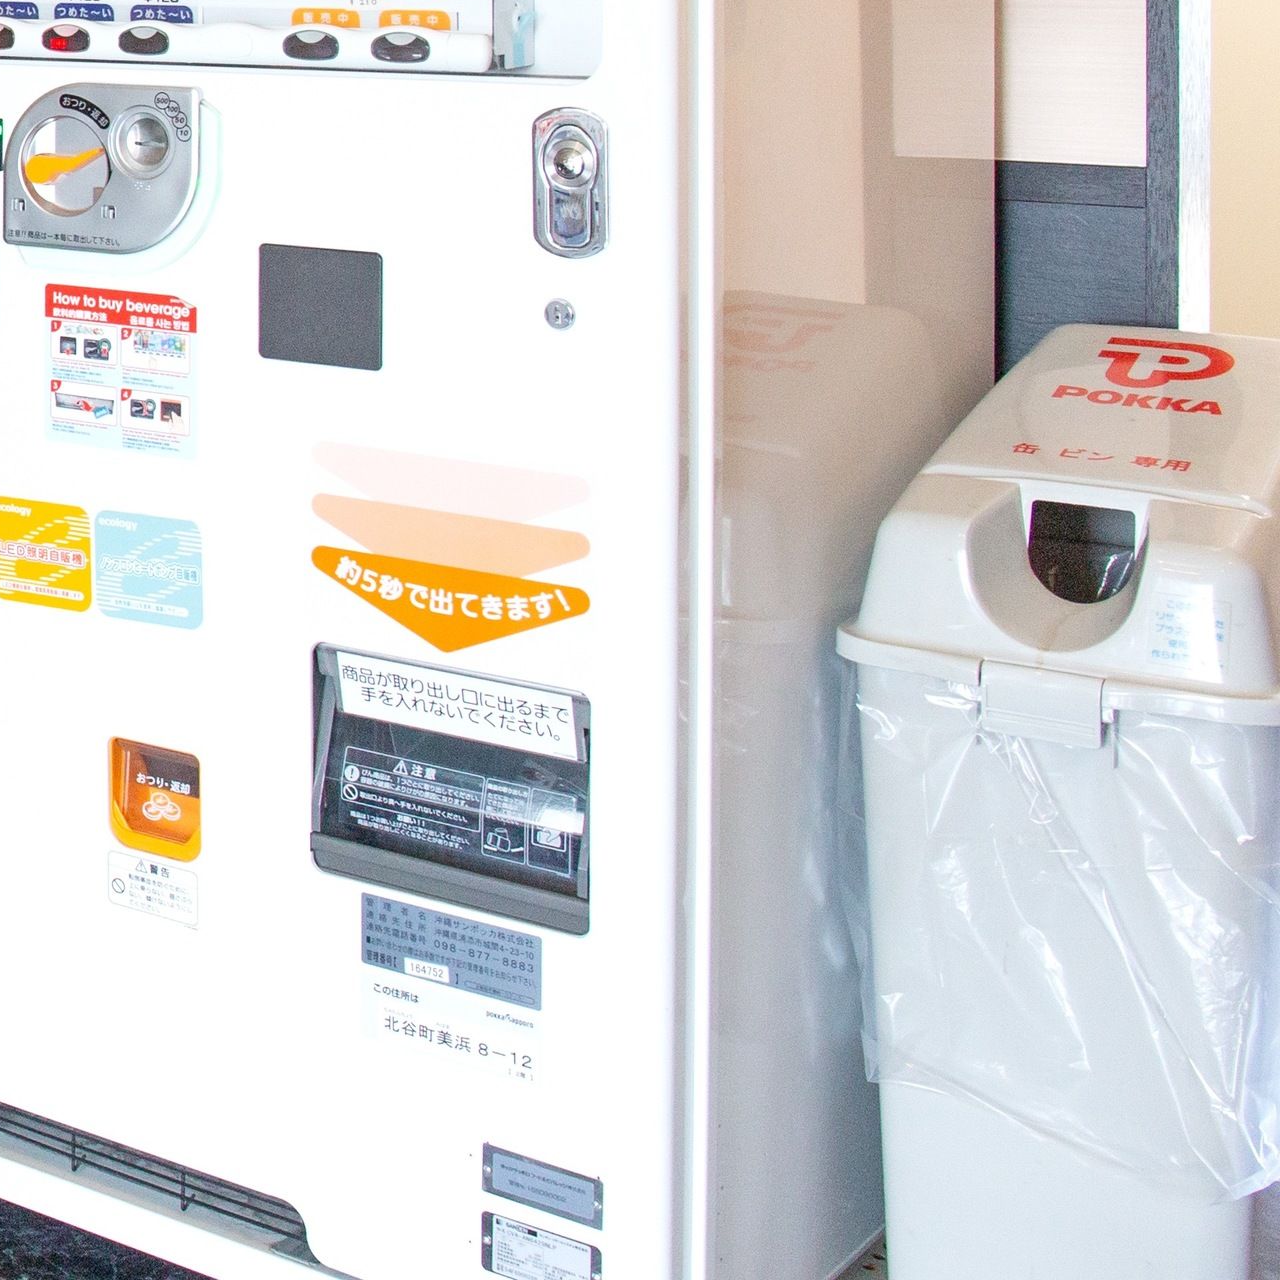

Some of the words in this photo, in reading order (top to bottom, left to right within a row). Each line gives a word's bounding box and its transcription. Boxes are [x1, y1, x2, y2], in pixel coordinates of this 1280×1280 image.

[62, 96, 109, 129] おつり・返却
[156, 97, 170, 105] 500
[52, 292, 80, 306] How
[83, 294, 96, 308] to
[98, 295, 123, 312] buy
[126, 297, 191, 319] beverage
[1050, 384, 1223, 416] POKKA
[1011, 442, 1041, 455] 缶
[1059, 448, 1114, 461] ビン
[1130, 454, 1192, 472] 専用
[98, 517, 138, 532] ecology
[334, 555, 571, 621] 約5秒で出てきます!
[341, 664, 569, 724] 商品が取り出し口に出るまで
[360, 687, 561, 742] 手を入れないでください。
[136, 772, 191, 795] おつり・返却
[410, 763, 437, 780] 注意
[434, 916, 535, 948] 沖縄サンポッカ株式会社
[410, 962, 444, 978] 164752
[373, 982, 420, 1004] この住所は
